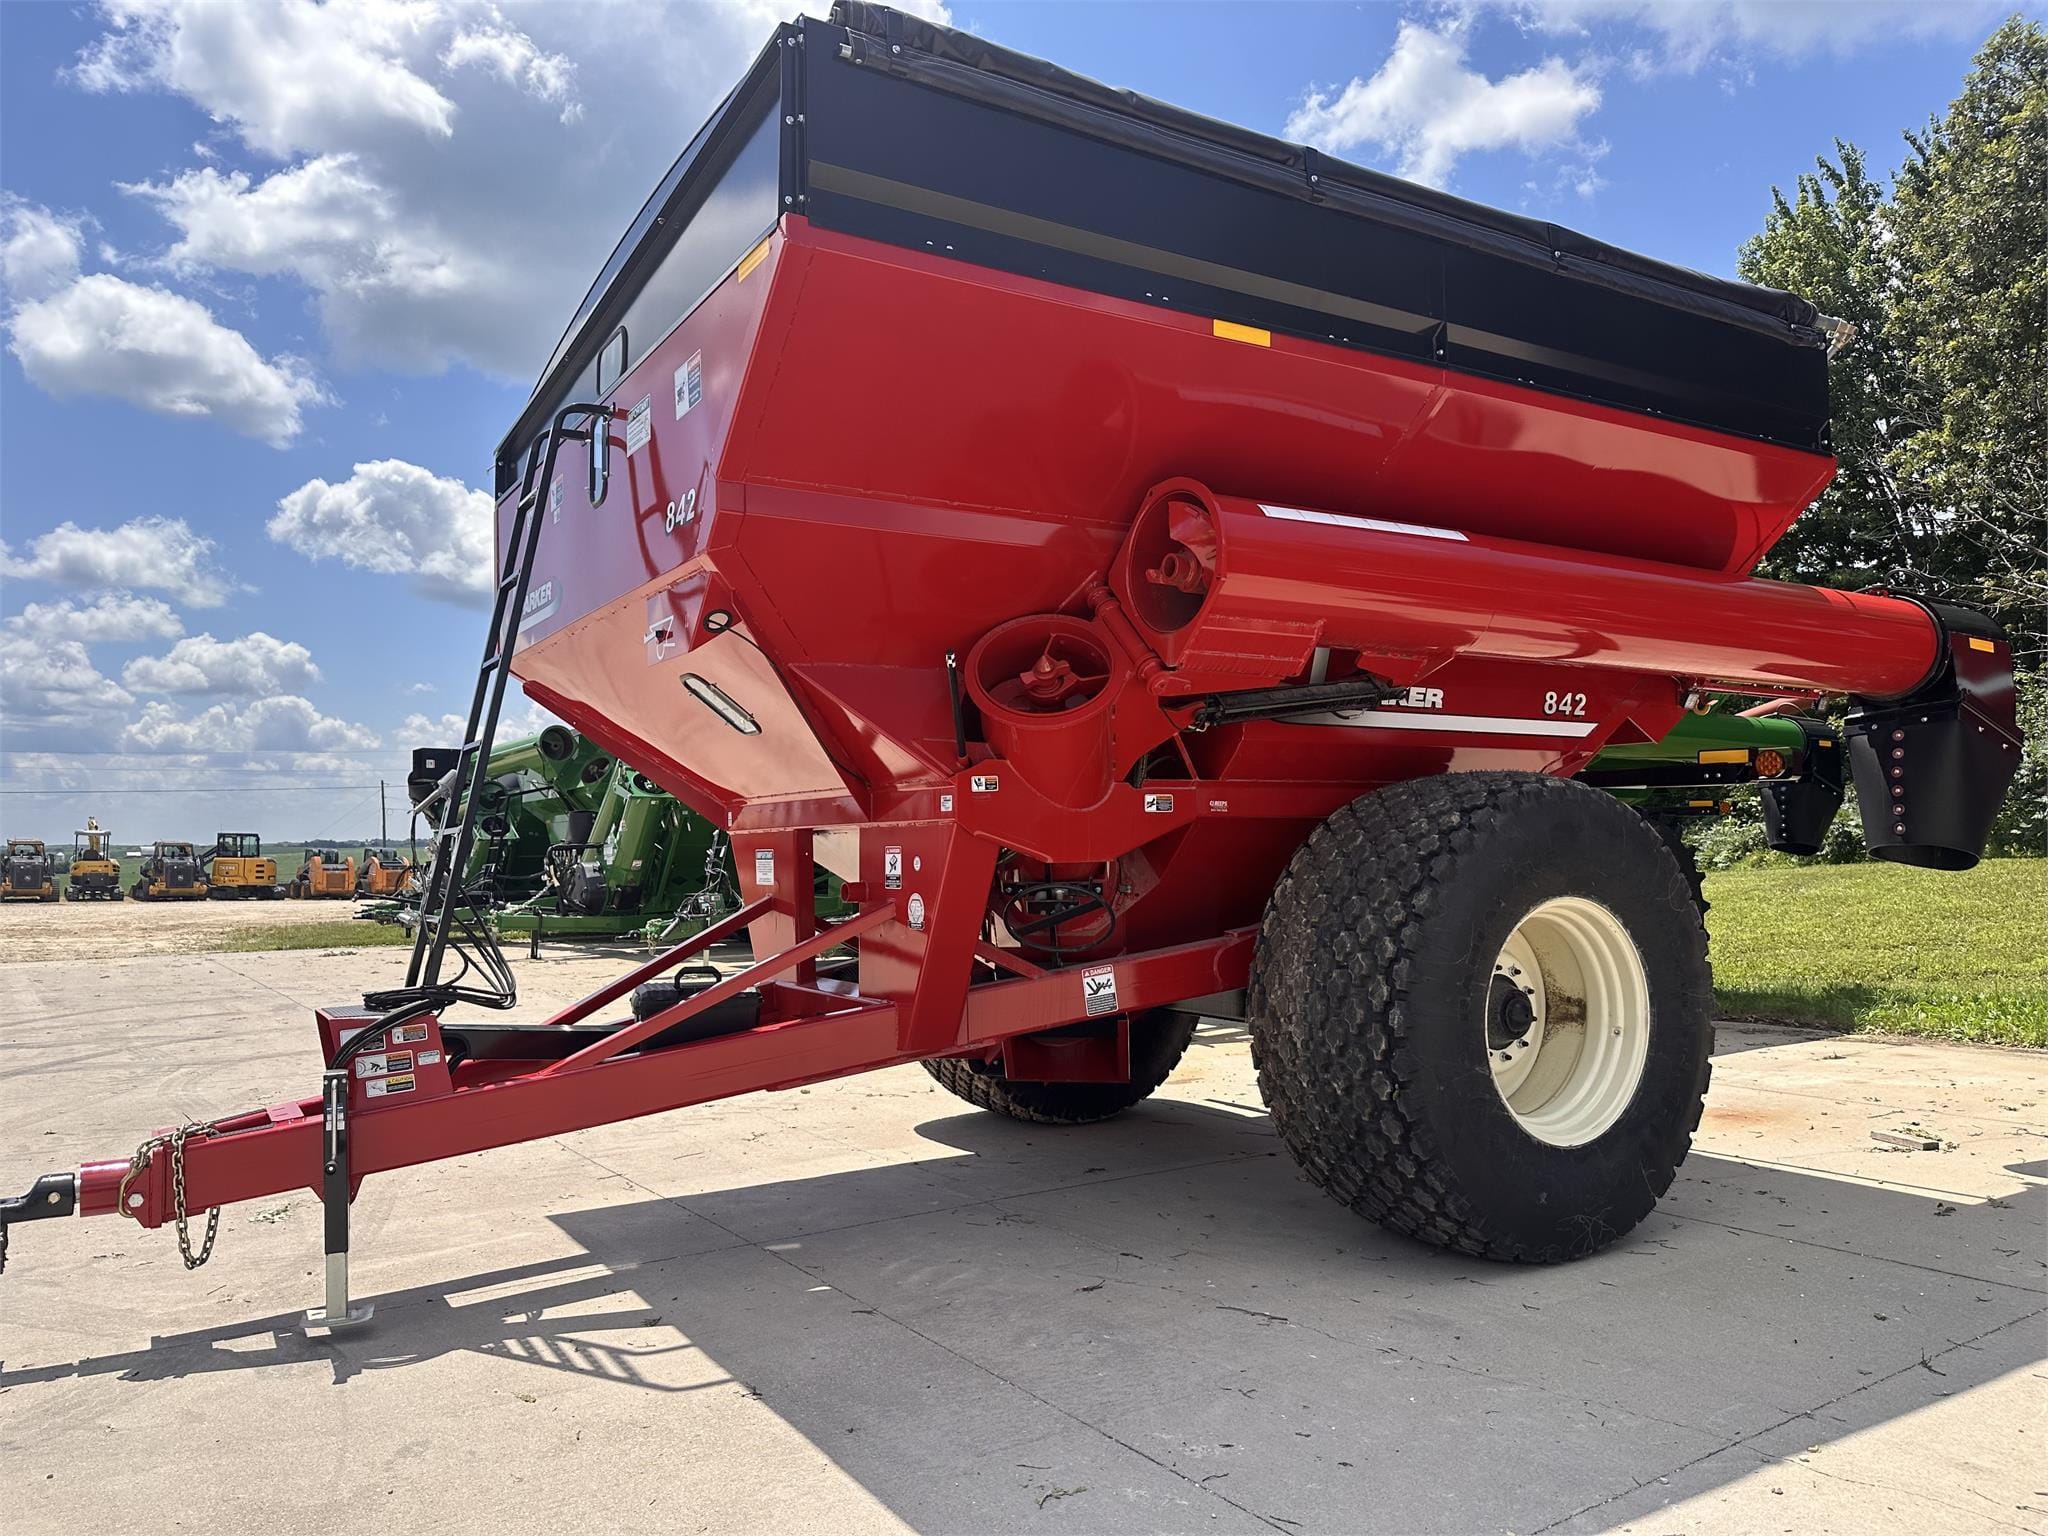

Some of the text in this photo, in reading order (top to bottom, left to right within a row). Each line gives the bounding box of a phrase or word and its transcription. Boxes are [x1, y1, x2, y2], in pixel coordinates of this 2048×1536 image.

[666, 488, 696, 533] 842
[521, 581, 552, 616] ARKER
[1544, 691, 1587, 716] 842
